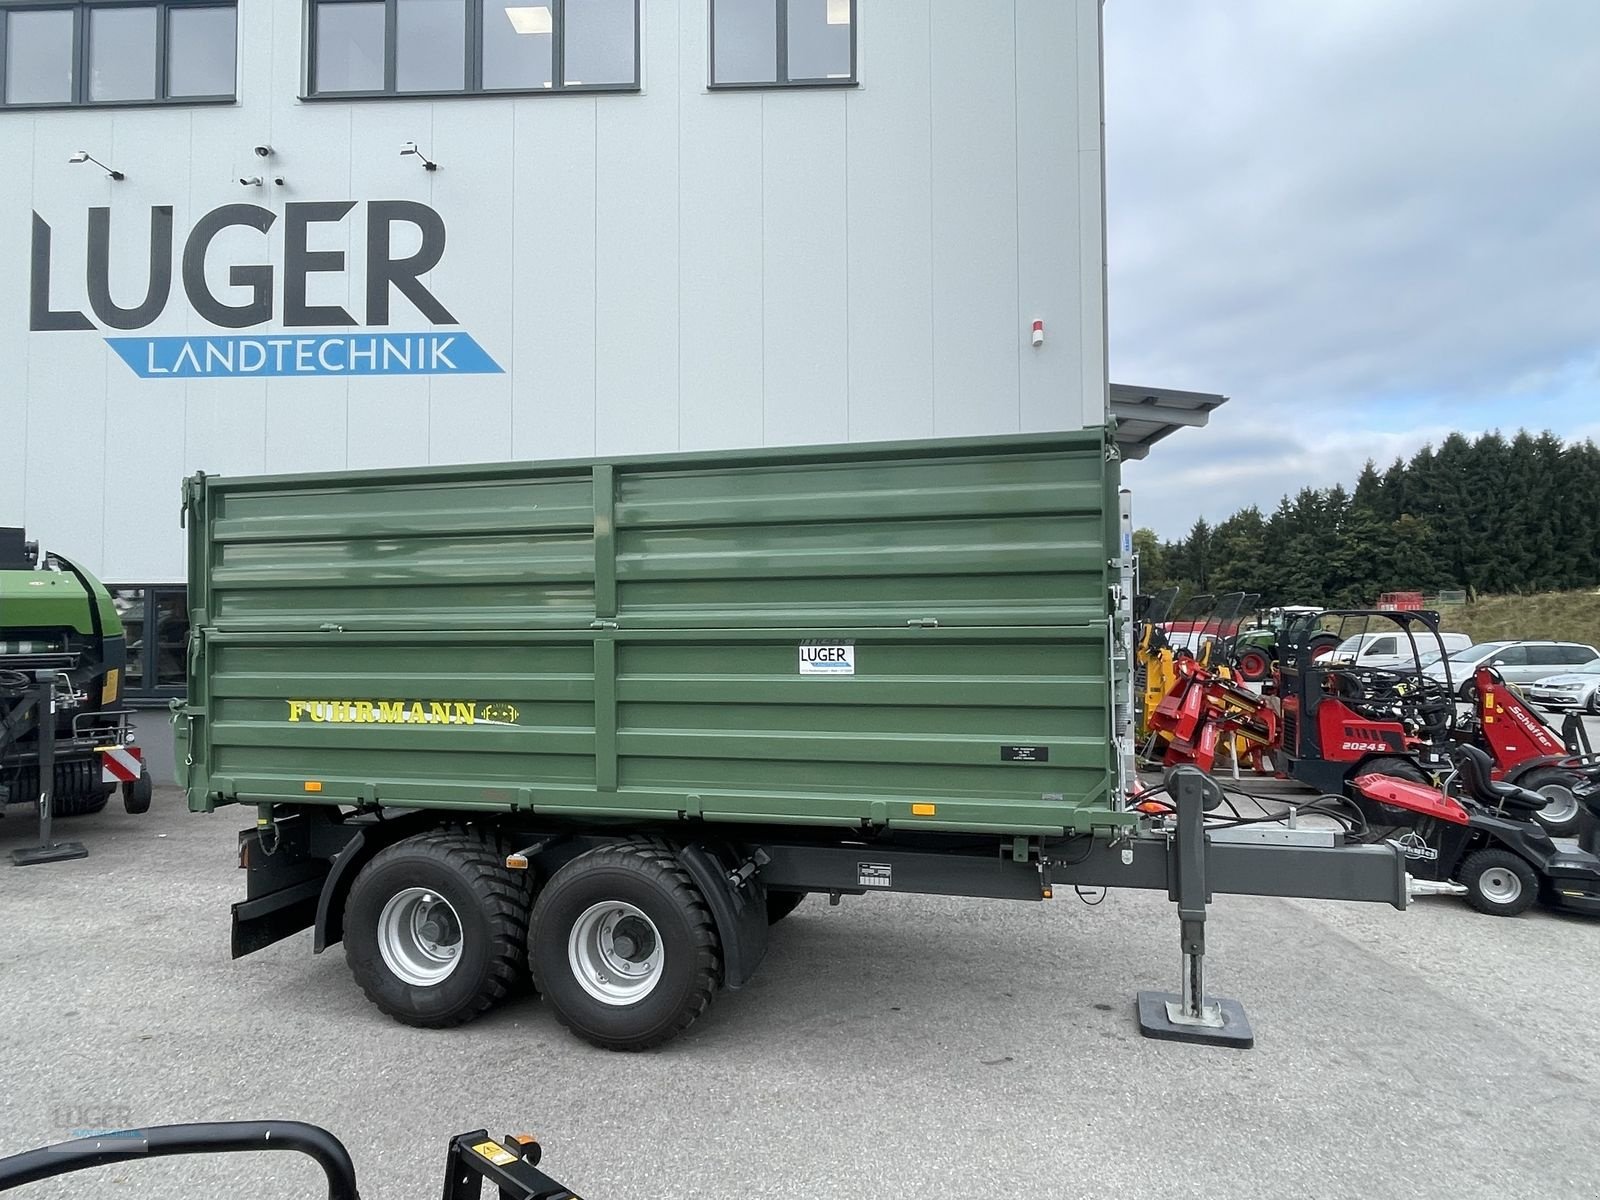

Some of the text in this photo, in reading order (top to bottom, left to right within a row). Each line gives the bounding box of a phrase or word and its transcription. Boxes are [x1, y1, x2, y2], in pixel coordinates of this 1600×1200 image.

[30, 201, 460, 331] LUGER
[147, 337, 458, 374] LANDTECHNIK
[801, 648, 846, 661] LUGER
[288, 700, 476, 725] FUHRMANN
[1342, 742, 1376, 751] 2024
